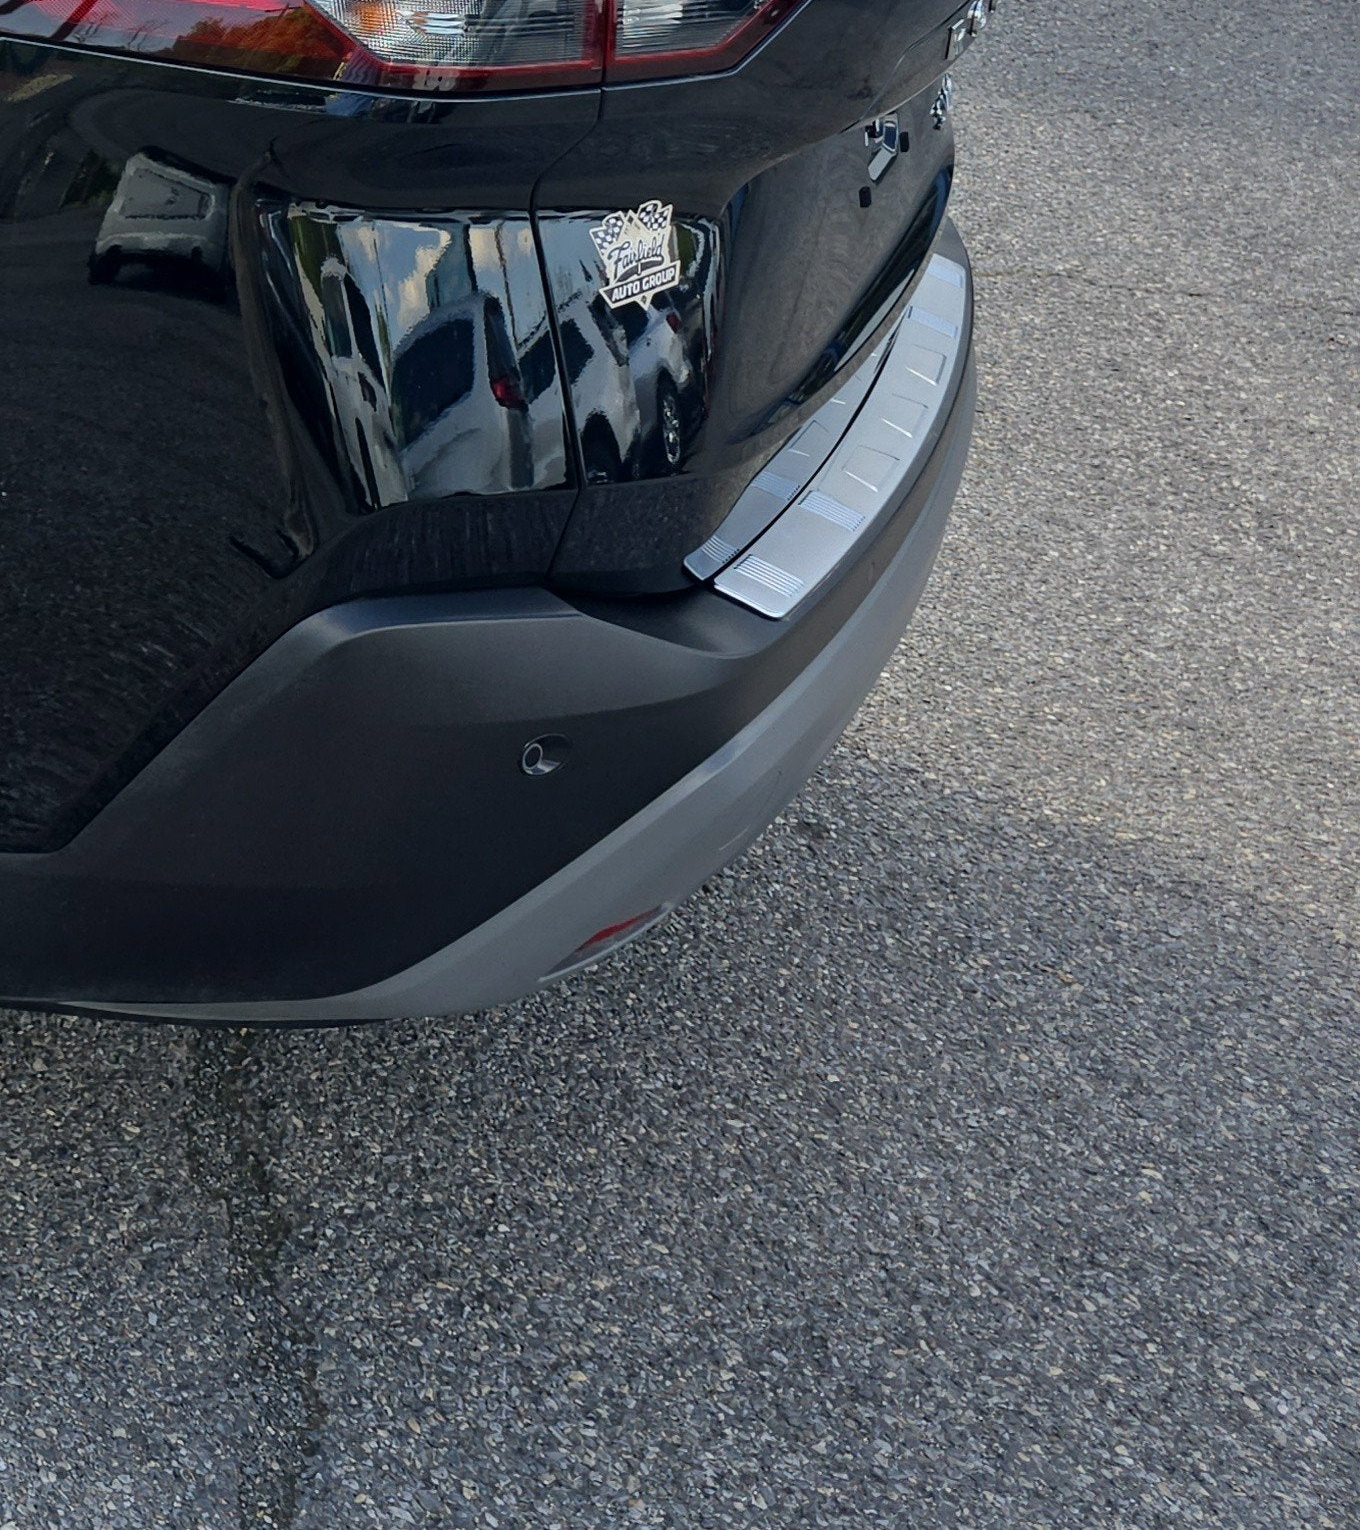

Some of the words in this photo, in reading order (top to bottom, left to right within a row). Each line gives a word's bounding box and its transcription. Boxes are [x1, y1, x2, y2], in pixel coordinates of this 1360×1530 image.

[607, 233, 666, 280] Fairfield
[611, 281, 640, 302] AUTO
[642, 267, 676, 290] GROUP
